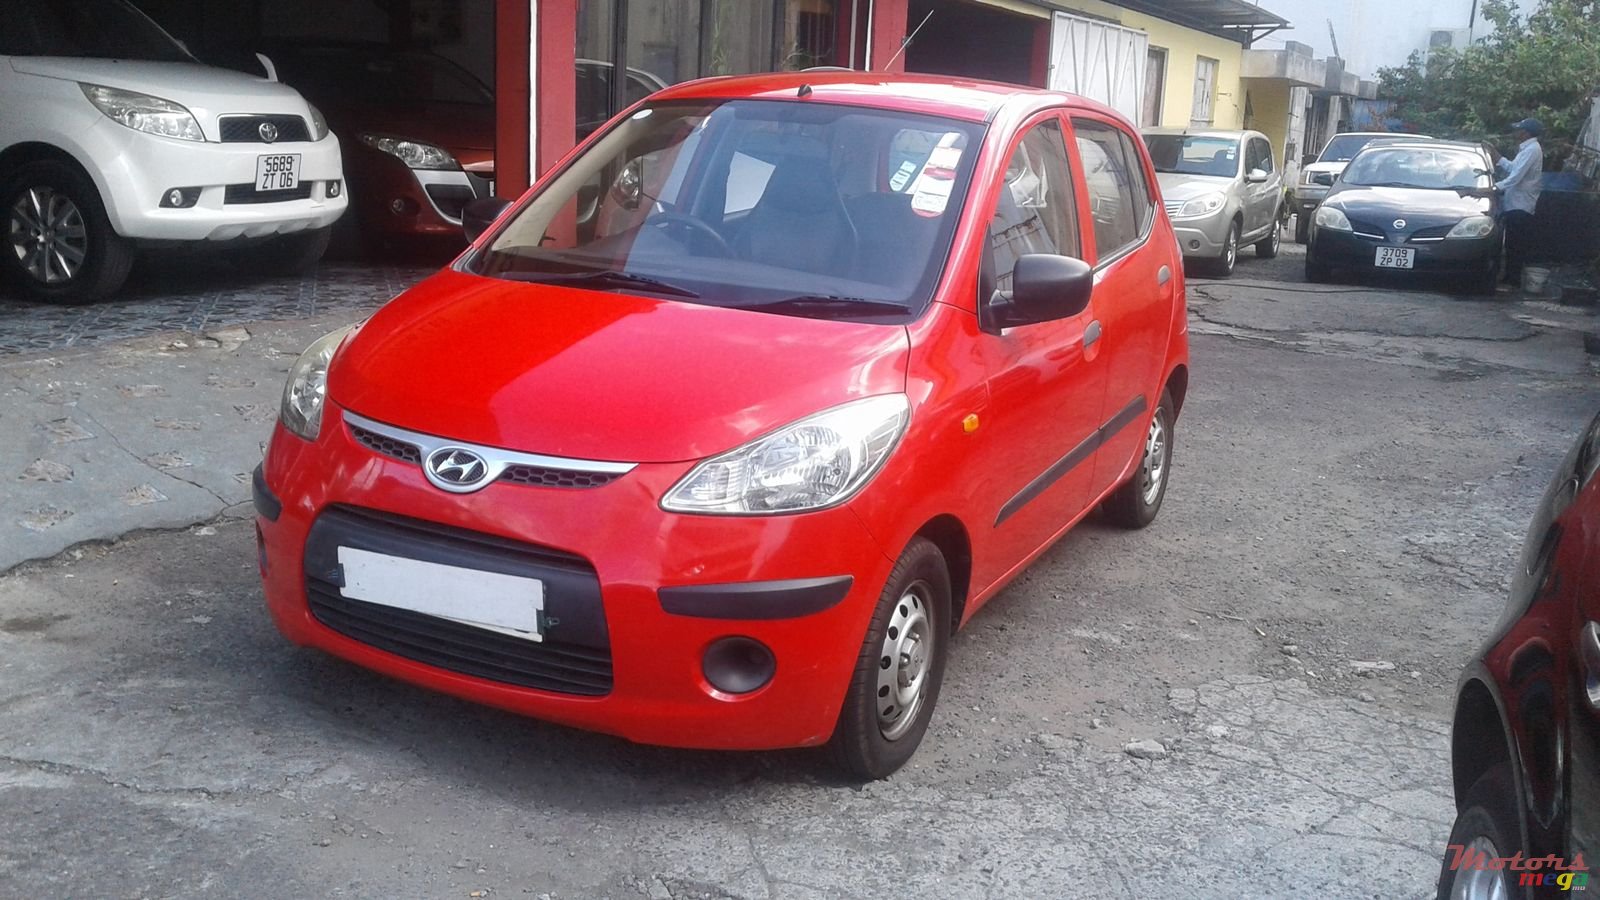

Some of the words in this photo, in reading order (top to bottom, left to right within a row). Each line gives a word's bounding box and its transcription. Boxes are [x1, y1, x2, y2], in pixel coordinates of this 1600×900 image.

[266, 156, 293, 172] 5689
[262, 173, 276, 189] ZT
[279, 172, 293, 187] 06
[1382, 248, 1407, 258] 3709
[1380, 257, 1392, 266] ZP
[1395, 258, 1408, 267] 02
